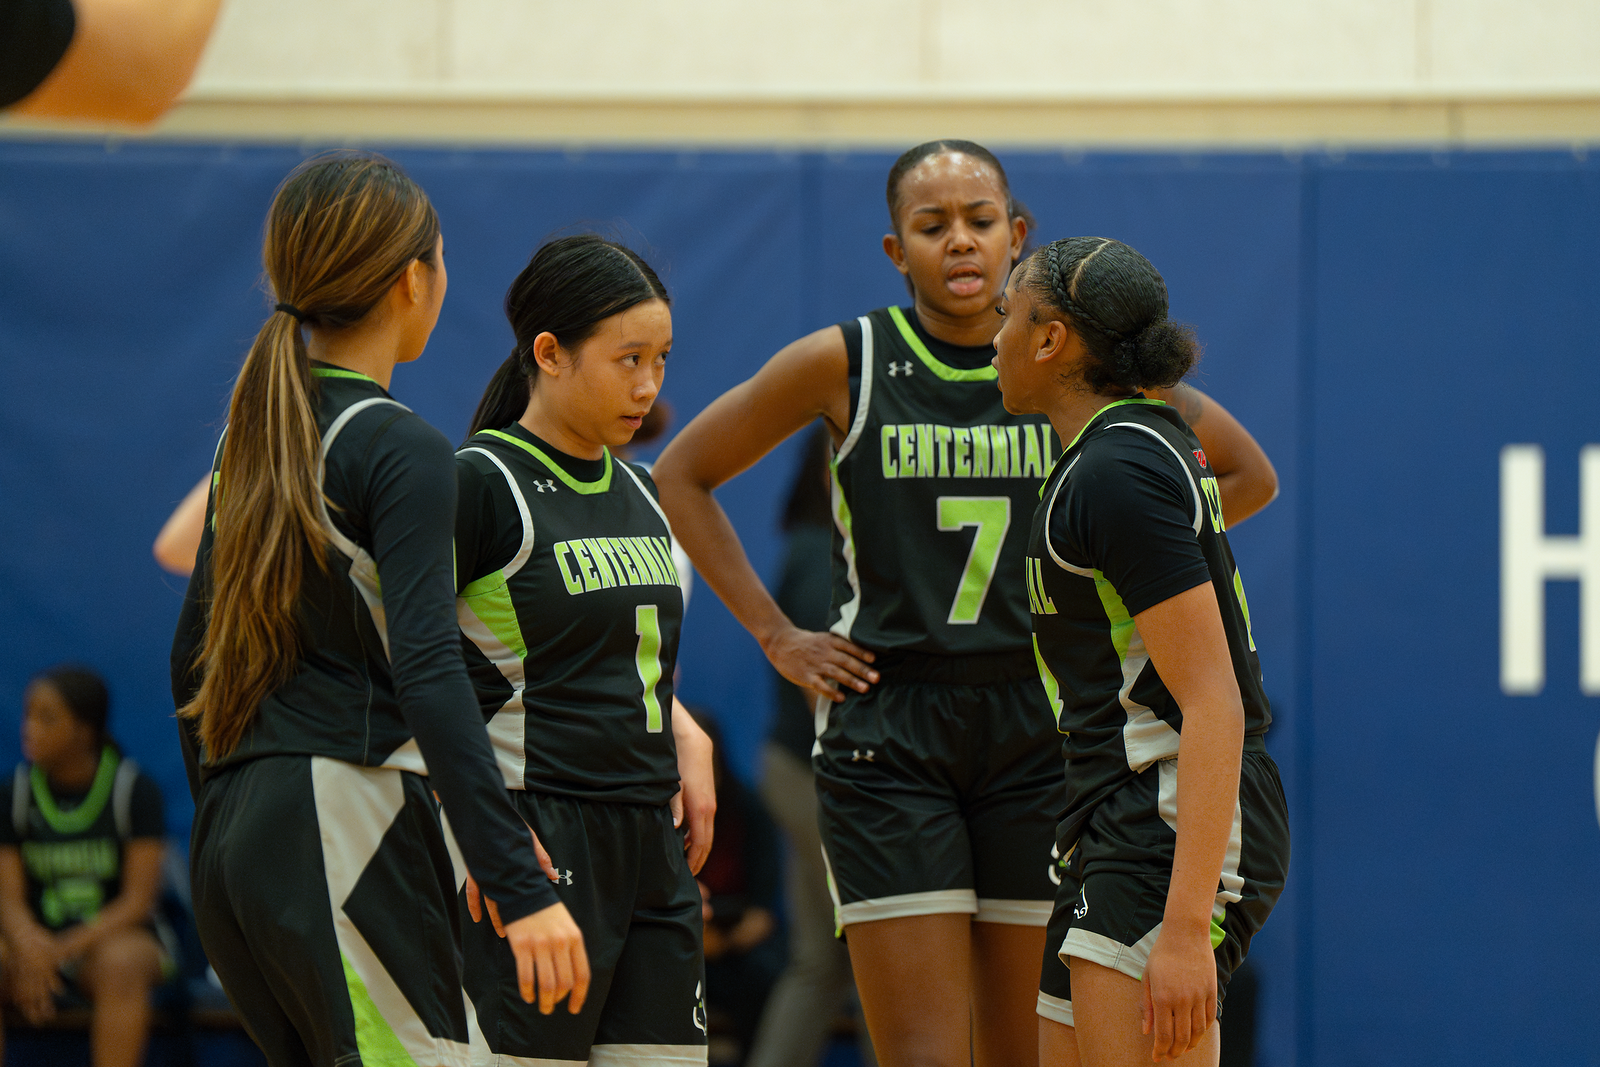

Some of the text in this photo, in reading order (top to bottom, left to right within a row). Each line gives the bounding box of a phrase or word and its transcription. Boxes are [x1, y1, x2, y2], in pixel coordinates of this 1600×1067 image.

[881, 424, 1056, 478] CENTENNIAL
[936, 496, 1011, 624] 7
[635, 604, 663, 733] 1
